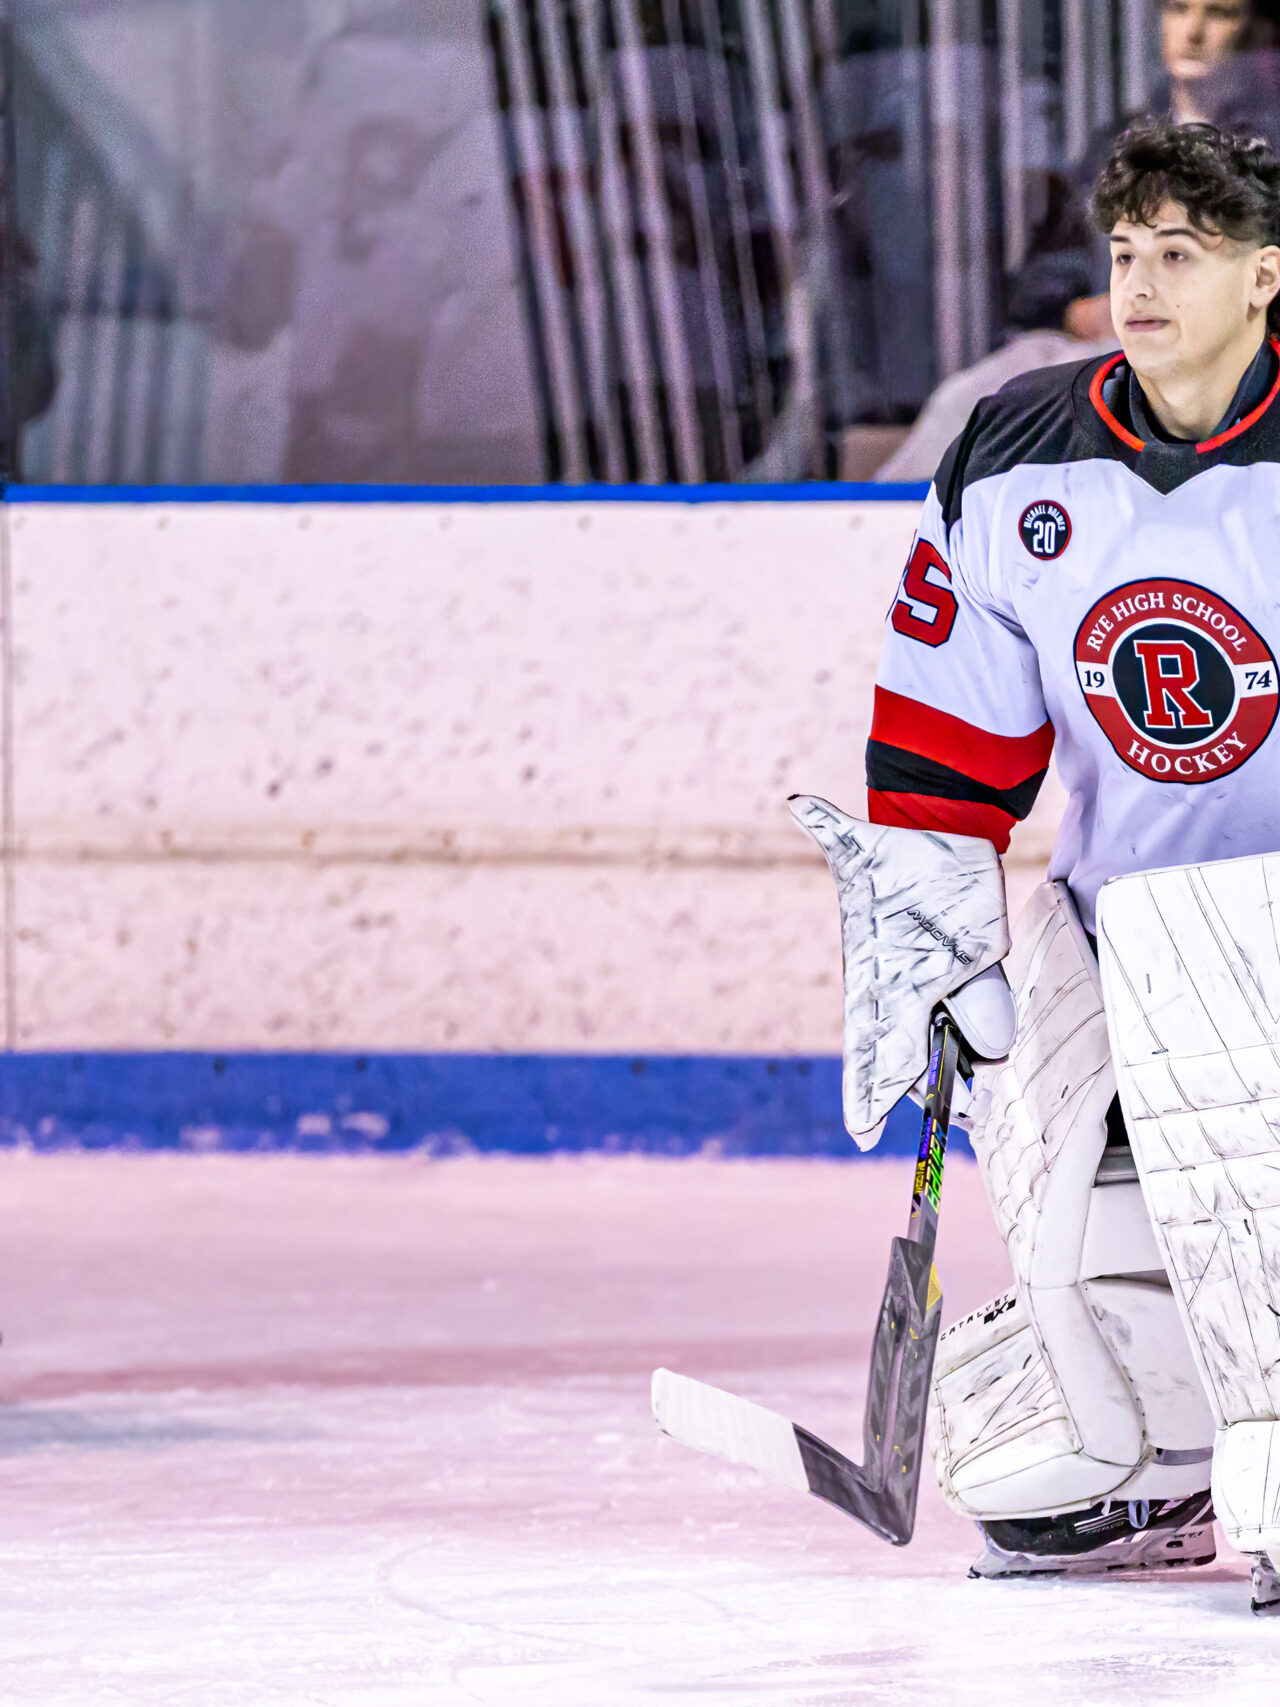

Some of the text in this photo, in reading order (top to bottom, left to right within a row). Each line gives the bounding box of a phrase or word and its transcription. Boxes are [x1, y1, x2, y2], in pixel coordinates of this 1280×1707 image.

[1032, 520, 1056, 554] 20
[885, 528, 959, 648] 5
[1086, 592, 1248, 652] RYE HIGH SCHOOL
[1084, 669, 1273, 690] 19 74
[1133, 639, 1214, 729] R
[1127, 731, 1247, 775] HOCKEY
[906, 909, 975, 966] SHADOW
[940, 1294, 1009, 1342] CATALYST
